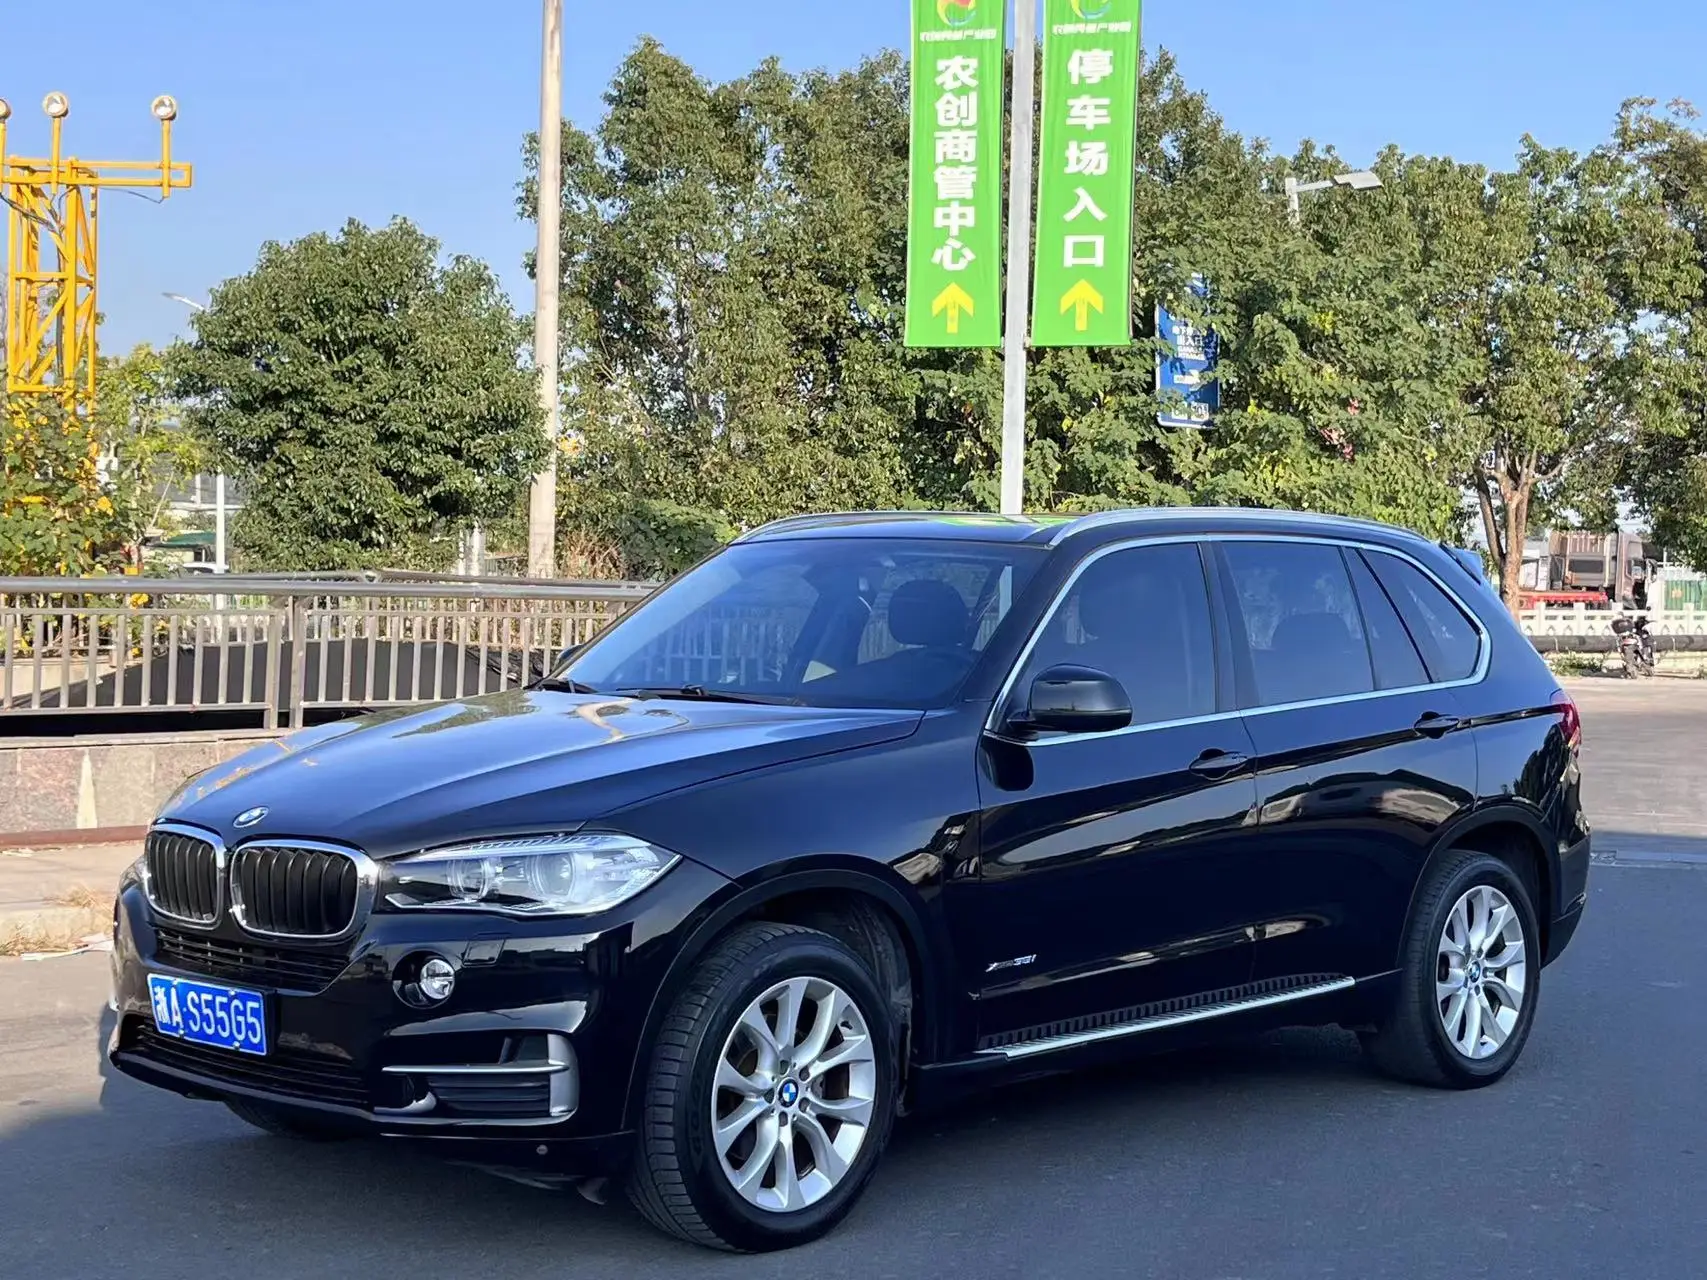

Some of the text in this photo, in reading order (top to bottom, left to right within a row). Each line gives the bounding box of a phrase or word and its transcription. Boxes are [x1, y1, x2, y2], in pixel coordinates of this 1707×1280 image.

[931, 55, 979, 271] 农创商管中心
[1063, 48, 1113, 267] 停车场入口
